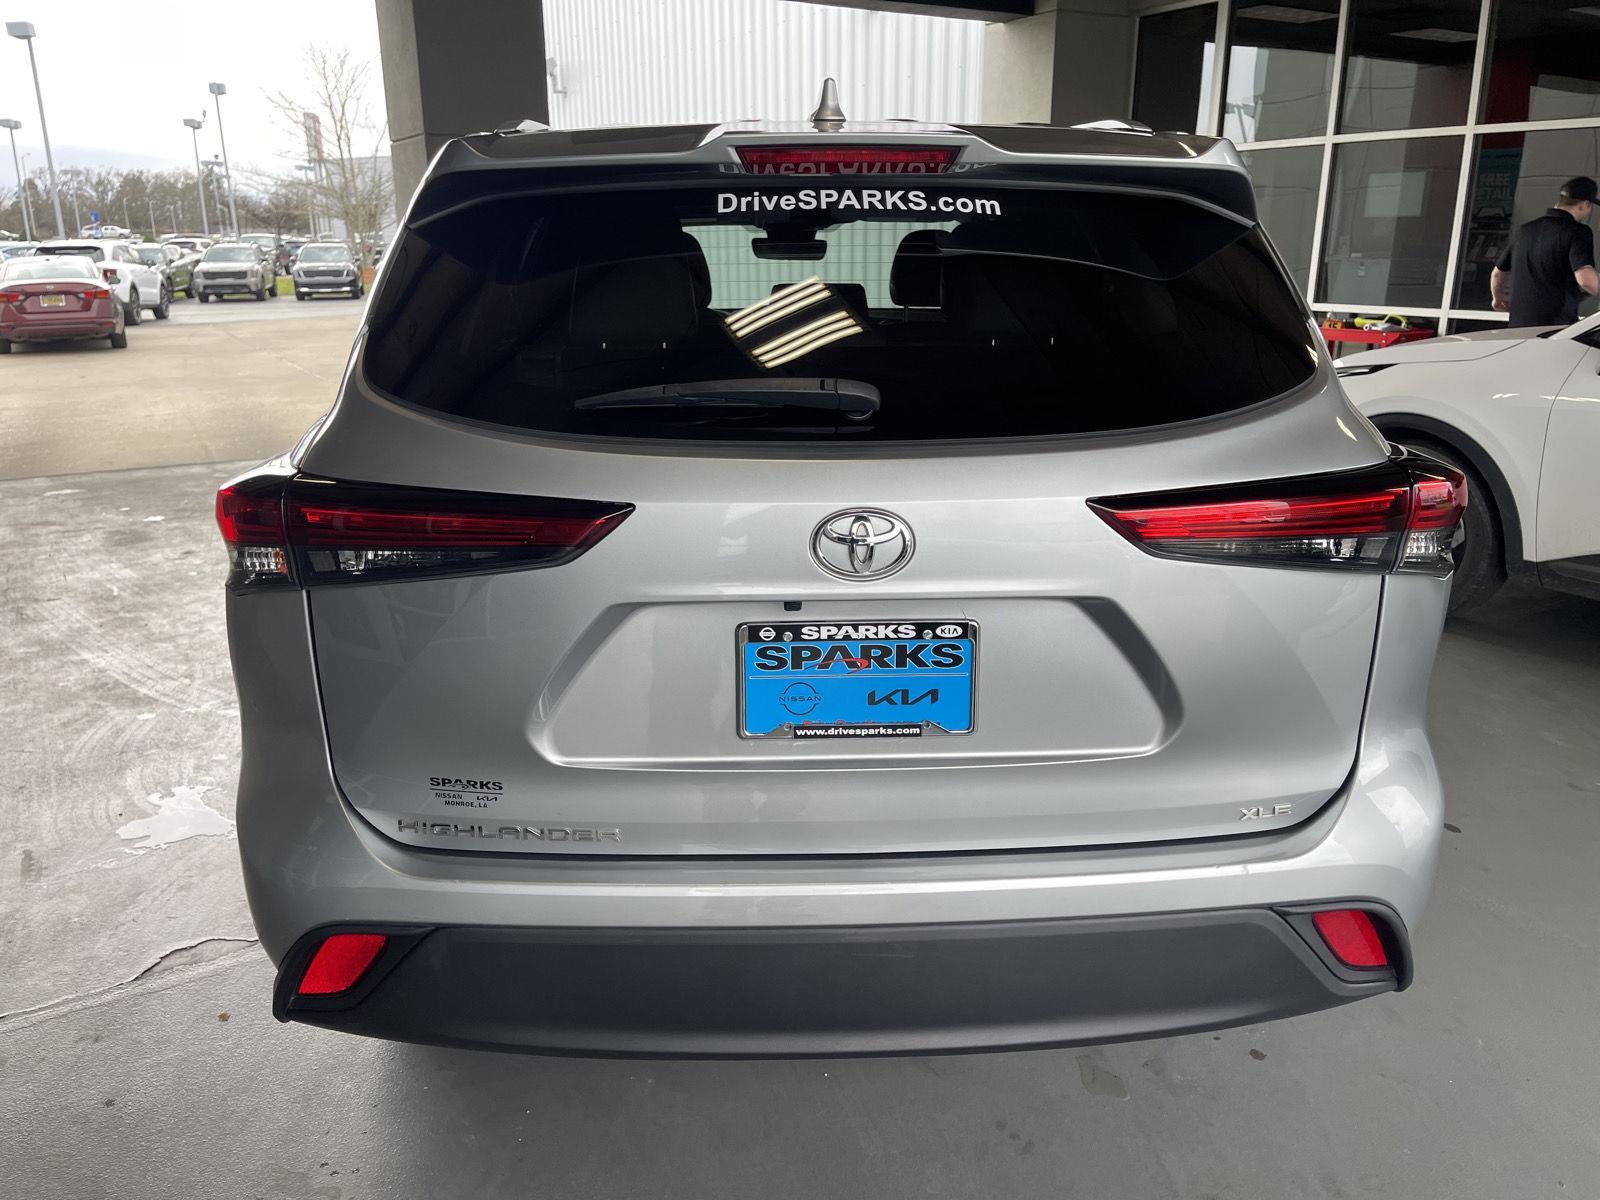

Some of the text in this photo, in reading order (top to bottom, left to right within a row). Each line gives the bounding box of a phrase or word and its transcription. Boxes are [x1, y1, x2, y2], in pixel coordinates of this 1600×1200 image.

[717, 189, 1002, 215] DriveSPARKS.com
[801, 625, 916, 640] SPARKS
[755, 643, 964, 670] SPARKS
[796, 727, 920, 737] www.drivesparks.com
[429, 777, 504, 791] SPARKS
[435, 792, 463, 800] NISSAN
[444, 800, 477, 809] MONROE,
[397, 818, 622, 843] HIGHLANDER
